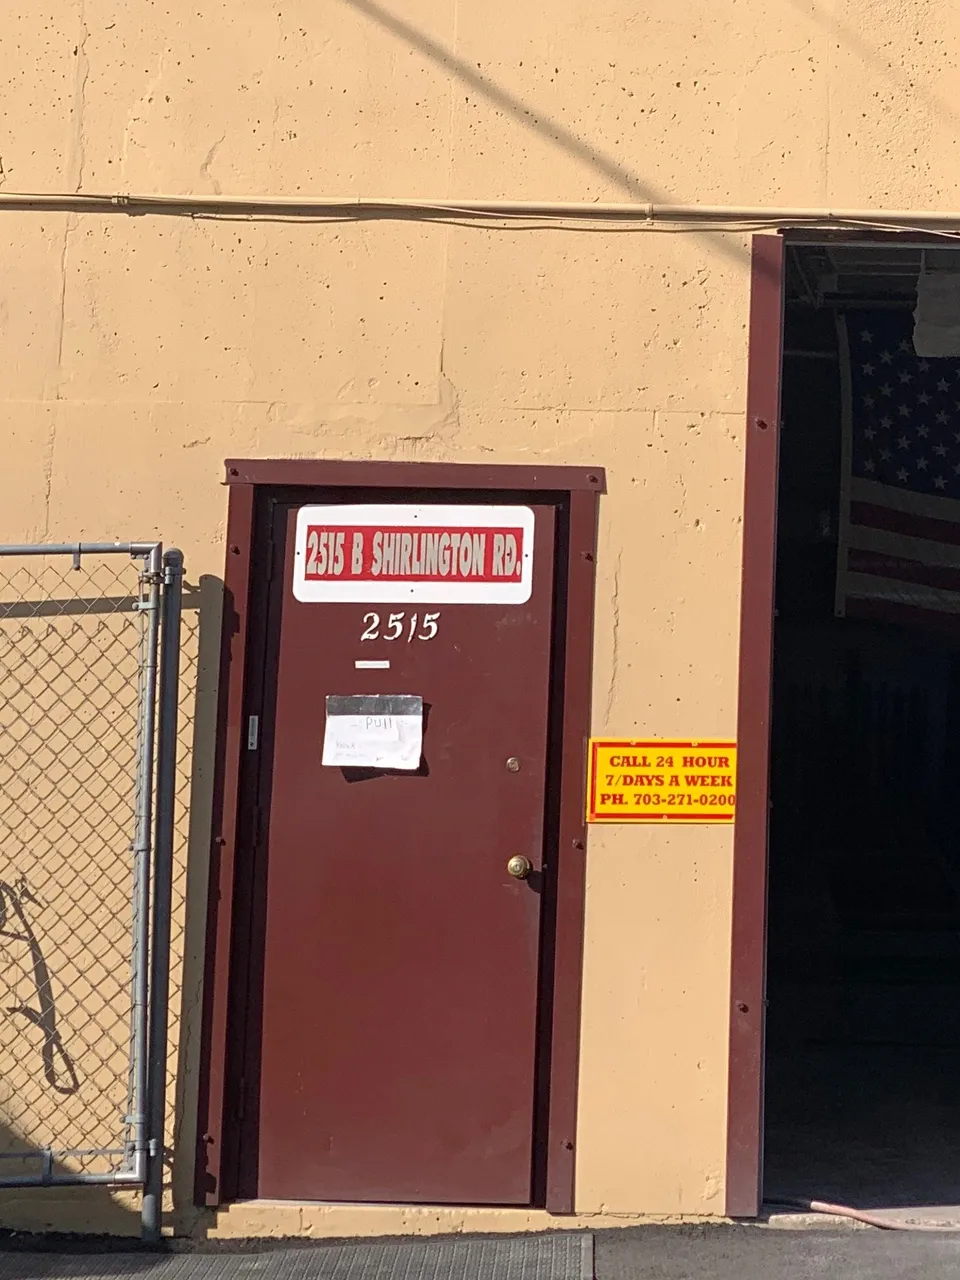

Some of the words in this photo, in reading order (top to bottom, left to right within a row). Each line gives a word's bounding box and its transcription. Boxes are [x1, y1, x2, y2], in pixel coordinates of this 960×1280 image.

[306, 531, 345, 575] 2515
[351, 532, 364, 575] B
[371, 531, 486, 577] SHIRLINGTON
[492, 534, 521, 576] RD.
[360, 612, 440, 642] 2515
[609, 756, 651, 767] CALL
[656, 756, 674, 767] 24
[682, 756, 730, 768] HOUR
[605, 774, 664, 787] 7/DAYS
[668, 775, 680, 786] A
[684, 775, 733, 787] WEEK
[600, 793, 628, 805] PH.
[634, 793, 736, 806] 703-271-0200
